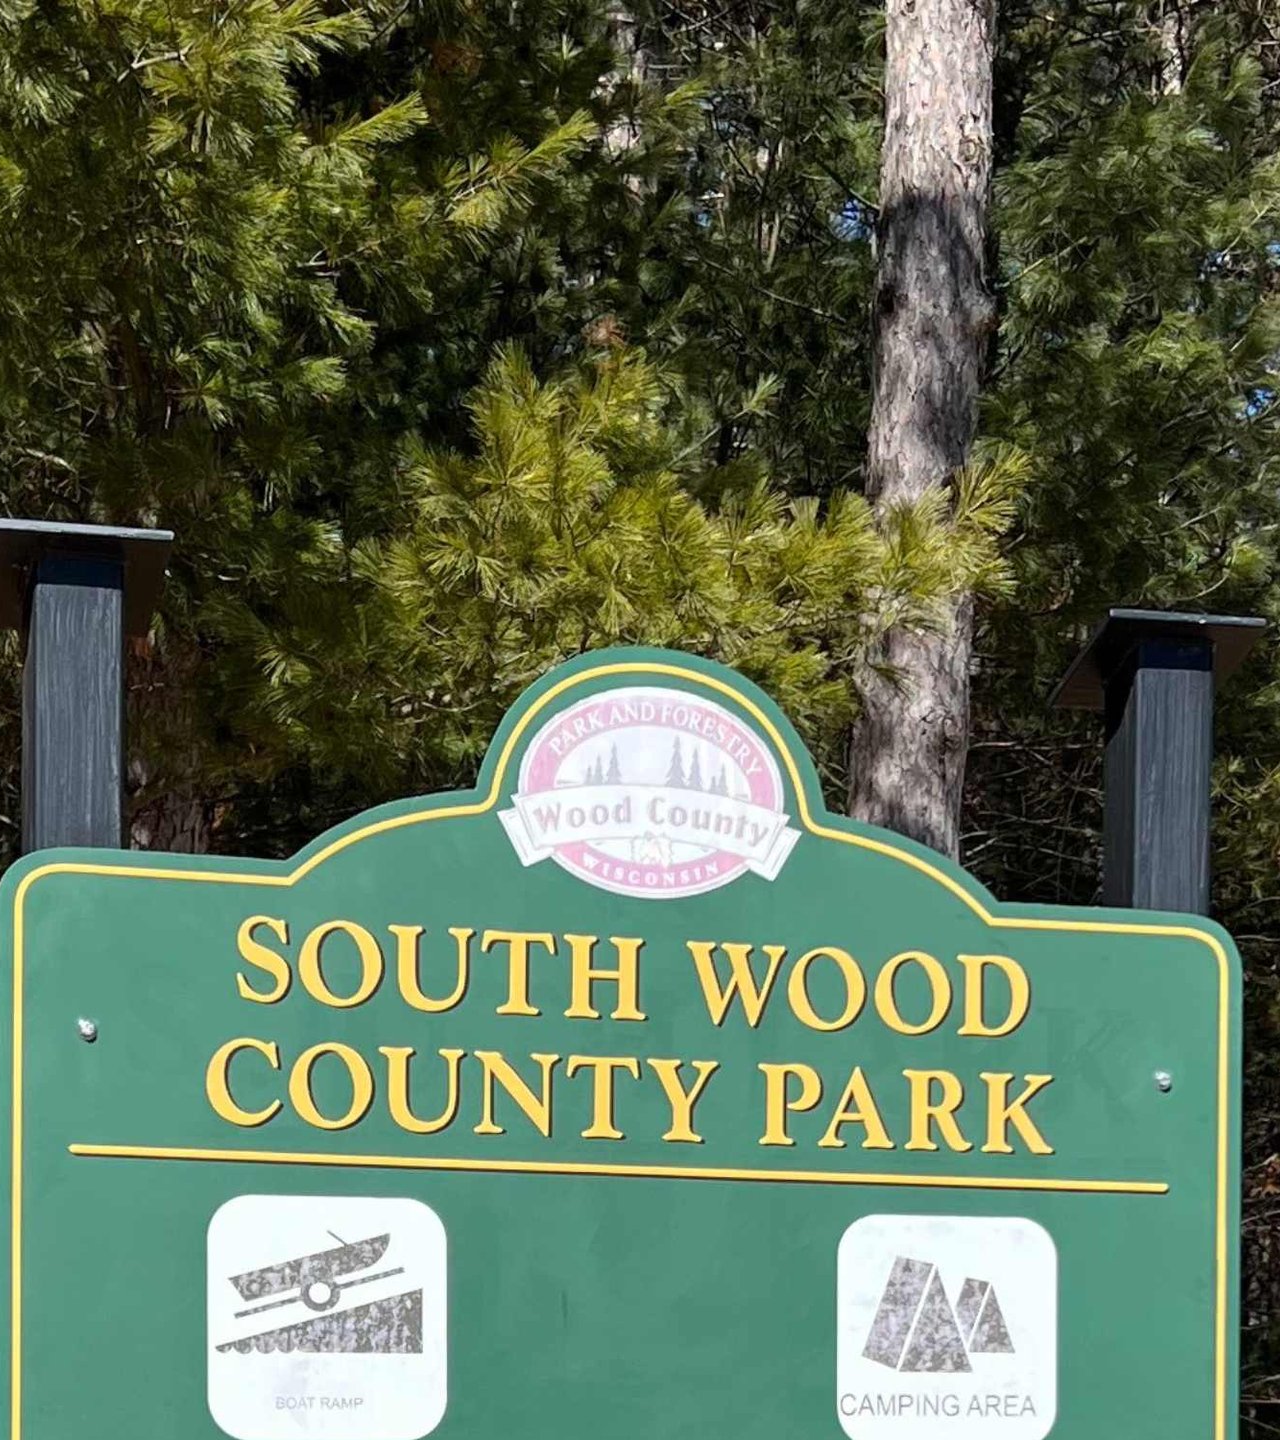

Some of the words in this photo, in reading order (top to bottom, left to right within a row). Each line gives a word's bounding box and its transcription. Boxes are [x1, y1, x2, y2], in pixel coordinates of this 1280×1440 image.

[550, 709, 605, 755] PARK
[609, 701, 655, 726] AND
[661, 705, 763, 776] FORESTRY
[534, 796, 632, 834] Wood
[648, 797, 770, 847] County
[579, 851, 720, 887] WISCONSIN
[236, 914, 647, 1021] SOUTH
[686, 940, 1031, 1037] WOOD
[205, 1037, 720, 1144] COUNTY
[758, 1062, 1056, 1155] PARK
[275, 1397, 316, 1411] BOAT
[320, 1397, 364, 1411] RAMP
[839, 1393, 960, 1418] CAMPING
[966, 1395, 1037, 1418] AREA
